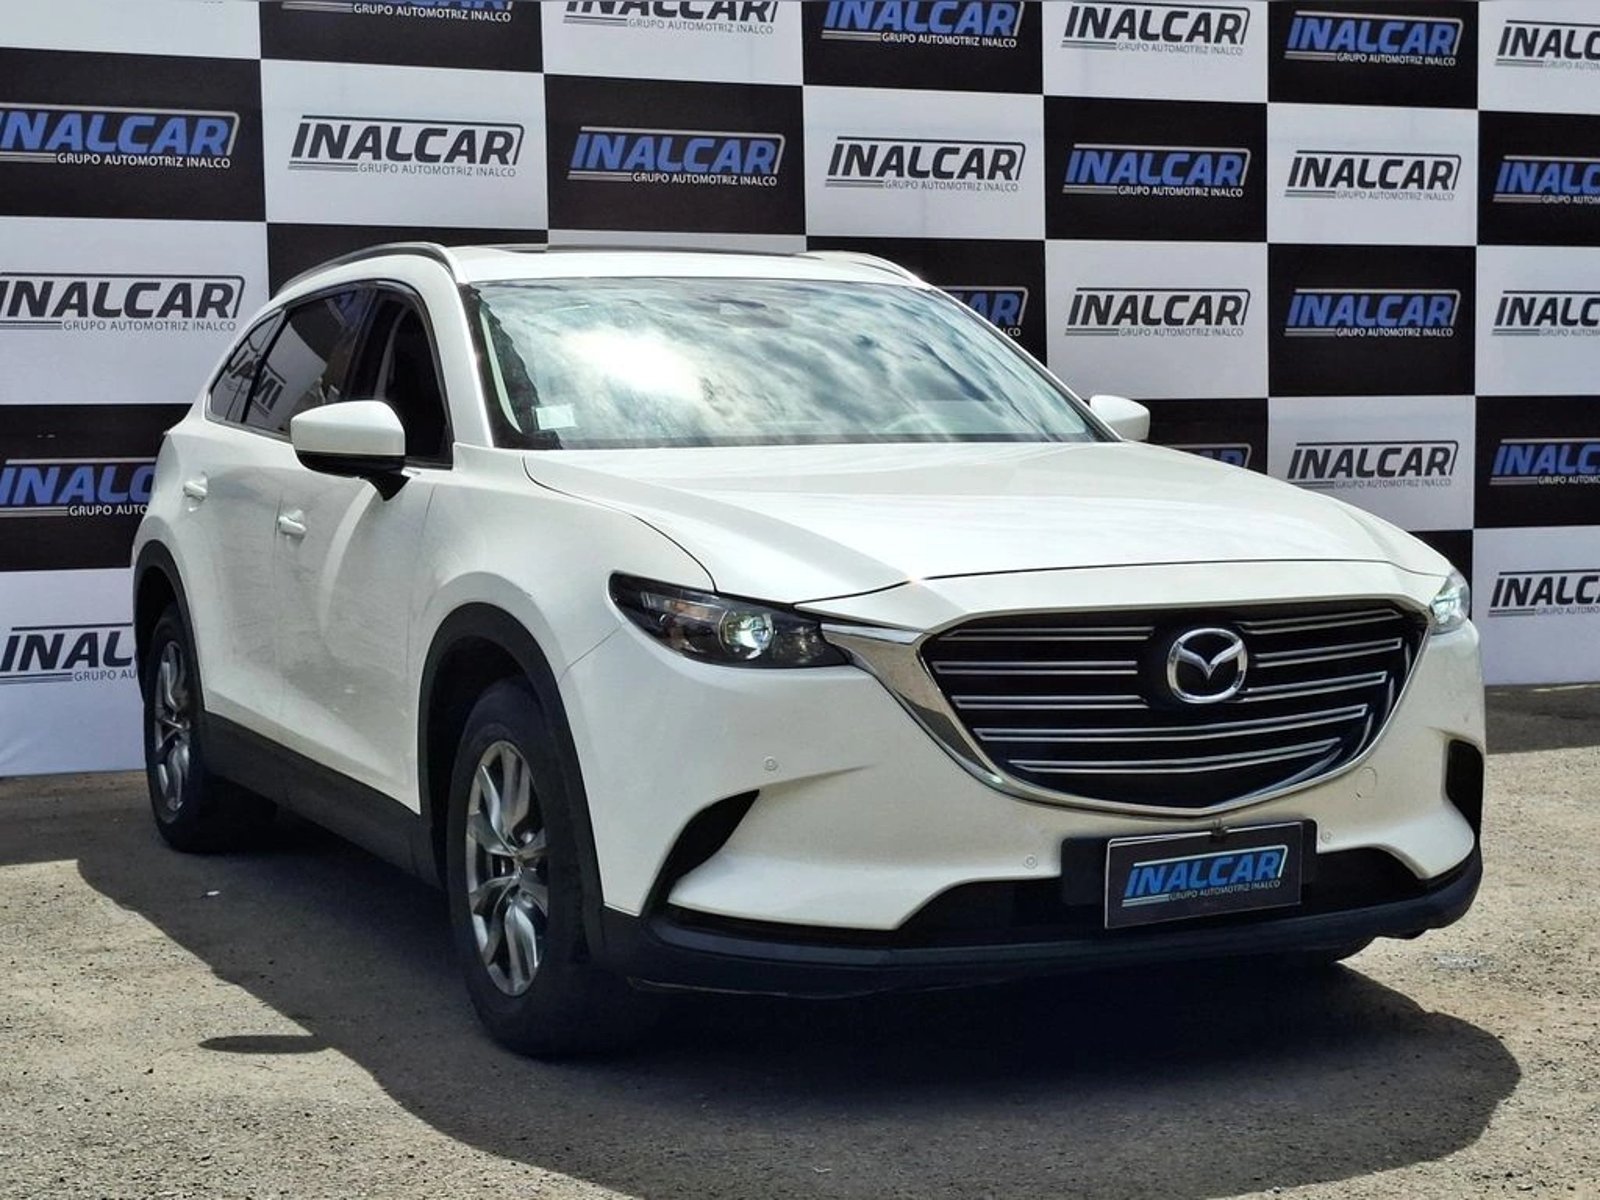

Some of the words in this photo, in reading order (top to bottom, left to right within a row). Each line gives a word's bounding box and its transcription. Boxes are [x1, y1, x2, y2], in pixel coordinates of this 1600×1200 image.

[354, 4, 393, 15] GRUPO
[397, 6, 468, 20] AUTOMOTRIZ
[471, 10, 512, 23] INALCO
[824, 1, 1016, 36] INALCAR
[629, 19, 665, 29] GRUPO
[668, 20, 734, 33] AUTOMOTRIZ
[736, 24, 774, 35] INALCO
[1064, 6, 1242, 44] INALCAR
[882, 32, 916, 43] GRUPO
[918, 33, 980, 46] AUTOMOTRIZ
[982, 36, 1017, 48] INALCO
[1287, 17, 1456, 55] INALCAR
[1116, 42, 1149, 52] GRUPO
[1151, 43, 1208, 54] AUTOMOTRIZ
[1211, 46, 1243, 56] INALCO
[1337, 52, 1367, 62] GRUPO
[1368, 53, 1423, 65] AUTOMOTRIZ
[1425, 56, 1456, 66] INALCO
[0, 111, 229, 155] NALCAR
[291, 122, 515, 165] INALCAR
[569, 133, 777, 174] INALCAR
[57, 152, 100, 164] GRUPO
[104, 155, 184, 167] AUTOMOTRIZ
[187, 157, 231, 168] INALCO
[359, 162, 398, 174] GRUPO
[401, 163, 473, 176] AUTOMOTRIZ
[475, 167, 516, 177] INALCO
[827, 143, 1017, 180] INALCAR
[1065, 150, 1243, 186] INALCAR
[633, 173, 669, 184] GRUPO
[672, 174, 738, 185] AUTOMOTRIZ
[740, 176, 777, 187] INALCO
[1287, 157, 1454, 190] INALCAR
[885, 179, 918, 189] GRUPO
[921, 180, 981, 191] AUTOMOTRIZ
[984, 182, 1018, 192] INALCO
[1118, 186, 1150, 195] GRUPO
[1151, 186, 1209, 197] AUTOMOTRIZ
[1210, 187, 1243, 197] INALCO
[1067, 294, 1243, 326] INALCAR
[1287, 295, 1453, 327] INALCAR
[63, 320, 106, 331] GRUPO
[110, 320, 188, 331] AUTOMOTRIZ
[192, 321, 236, 331] INALCO
[1119, 328, 1151, 337] GRUPO
[1153, 328, 1209, 337] AUTOMOTRIZ
[1211, 328, 1244, 337] INALCO
[1336, 328, 1366, 337] GRUPO
[1367, 328, 1421, 337] AUTOMOTRIZ
[1422, 328, 1454, 337] INALCO
[1287, 447, 1450, 479] INALCAR
[69, 505, 112, 516] GRUPO
[1490, 575, 1600, 608] INALC
[74, 670, 117, 681] GRUPO
[1125, 851, 1281, 898] INALCAR
[1169, 890, 1198, 901] GRUPO
[1199, 884, 1250, 897] AUTOMOTRIZ
[1251, 879, 1281, 891] INALCO
